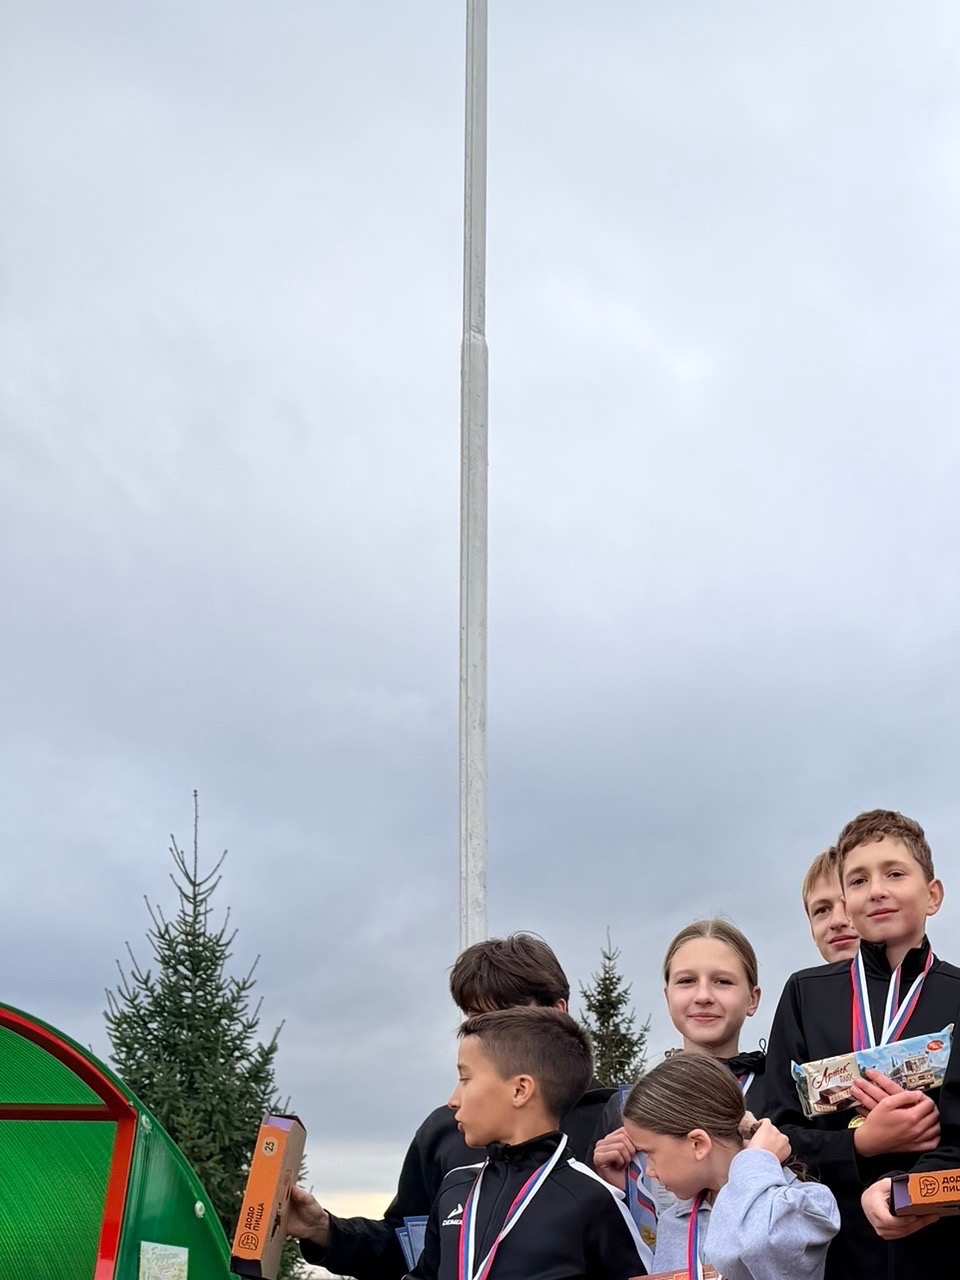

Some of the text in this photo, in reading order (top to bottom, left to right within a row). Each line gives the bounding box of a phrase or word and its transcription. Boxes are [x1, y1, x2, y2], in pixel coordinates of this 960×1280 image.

[812, 1062, 850, 1089] Артек
[265, 1141, 275, 1152] 25
[245, 1206, 256, 1230] ДОДО
[254, 1202, 264, 1232] ПИЦЦА
